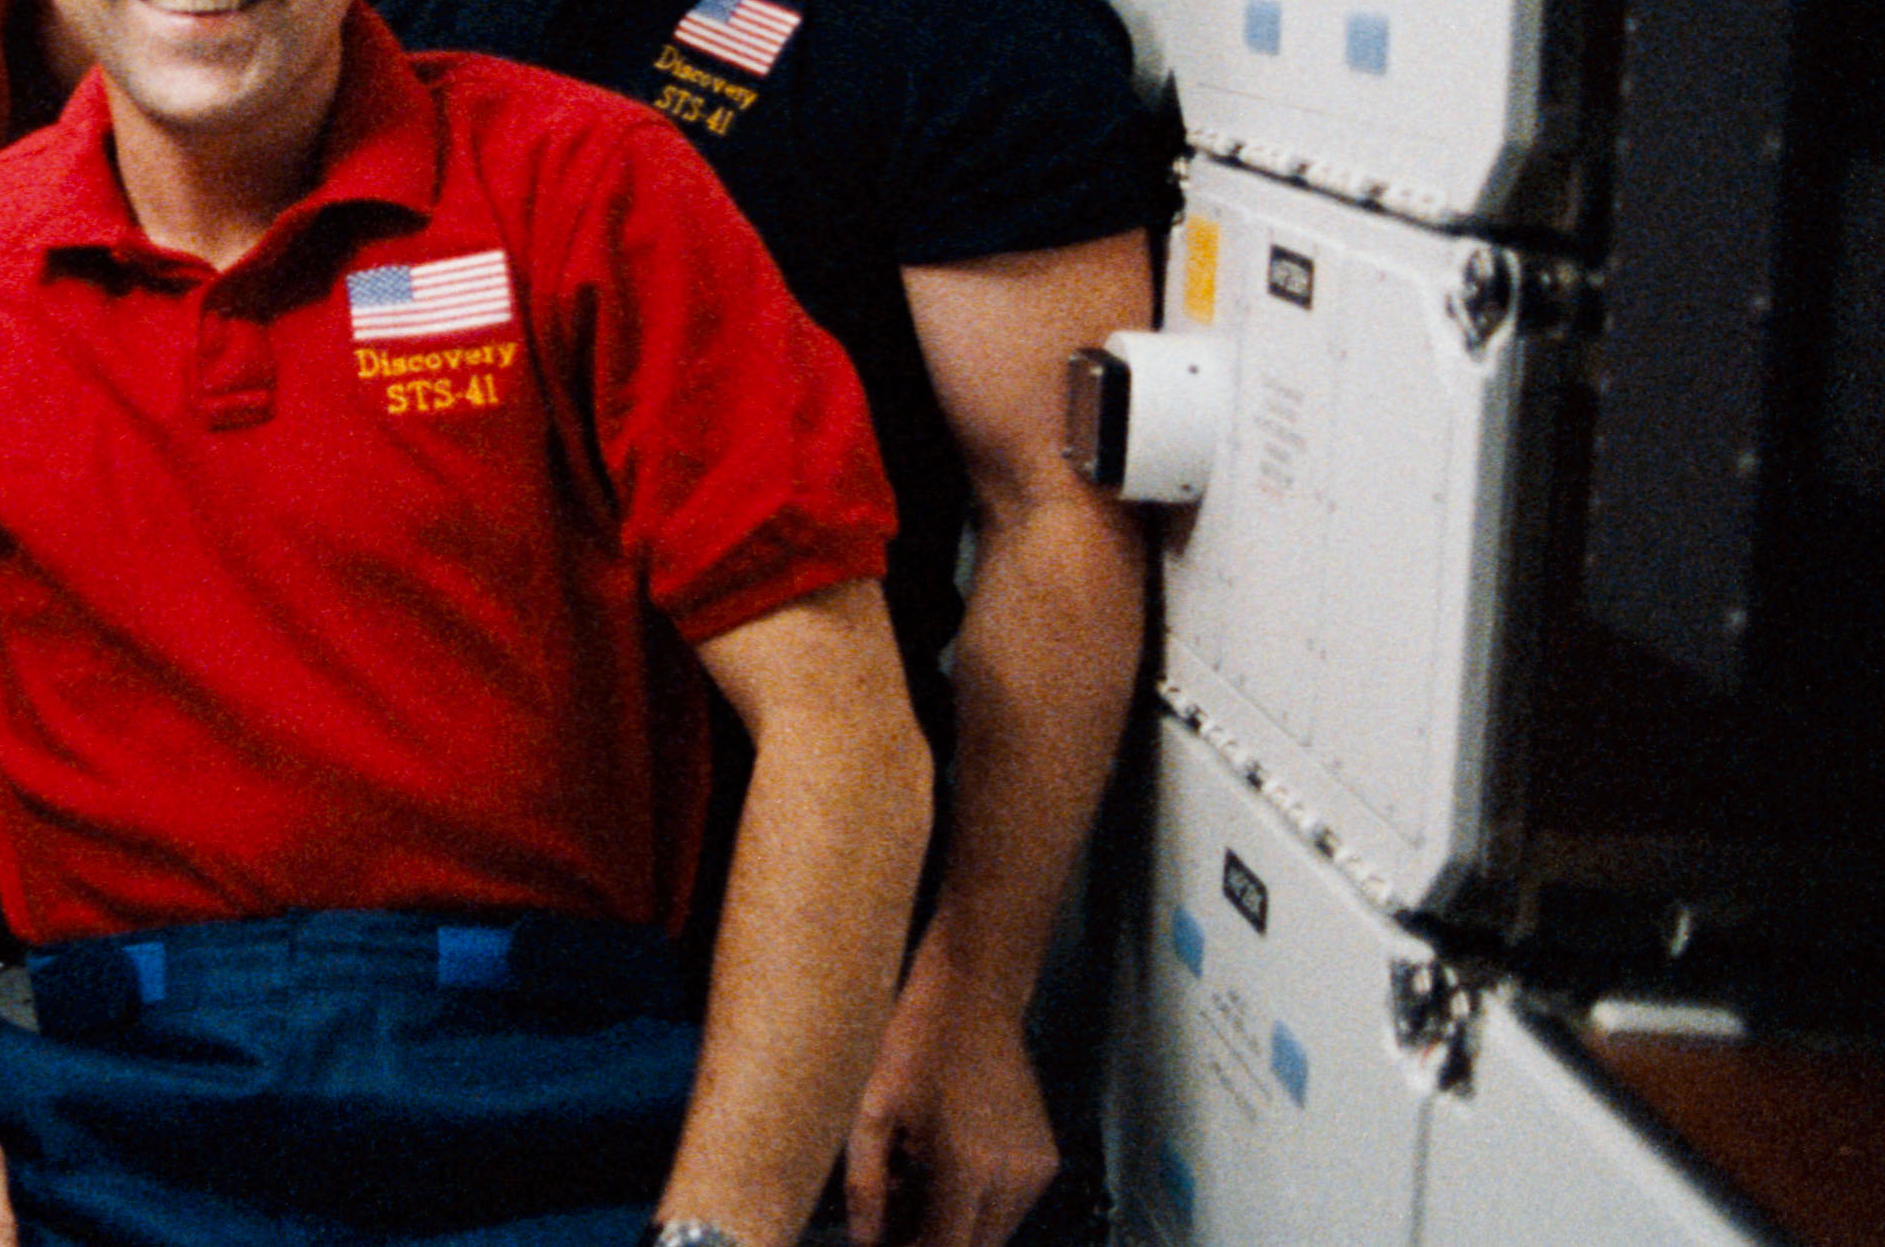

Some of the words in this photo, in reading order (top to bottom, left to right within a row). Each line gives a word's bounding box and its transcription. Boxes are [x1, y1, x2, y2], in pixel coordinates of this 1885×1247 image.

[653, 44, 759, 111] Discovery
[653, 84, 735, 136] STS-41
[354, 342, 518, 380] Discovery
[386, 372, 499, 415] STS-41
